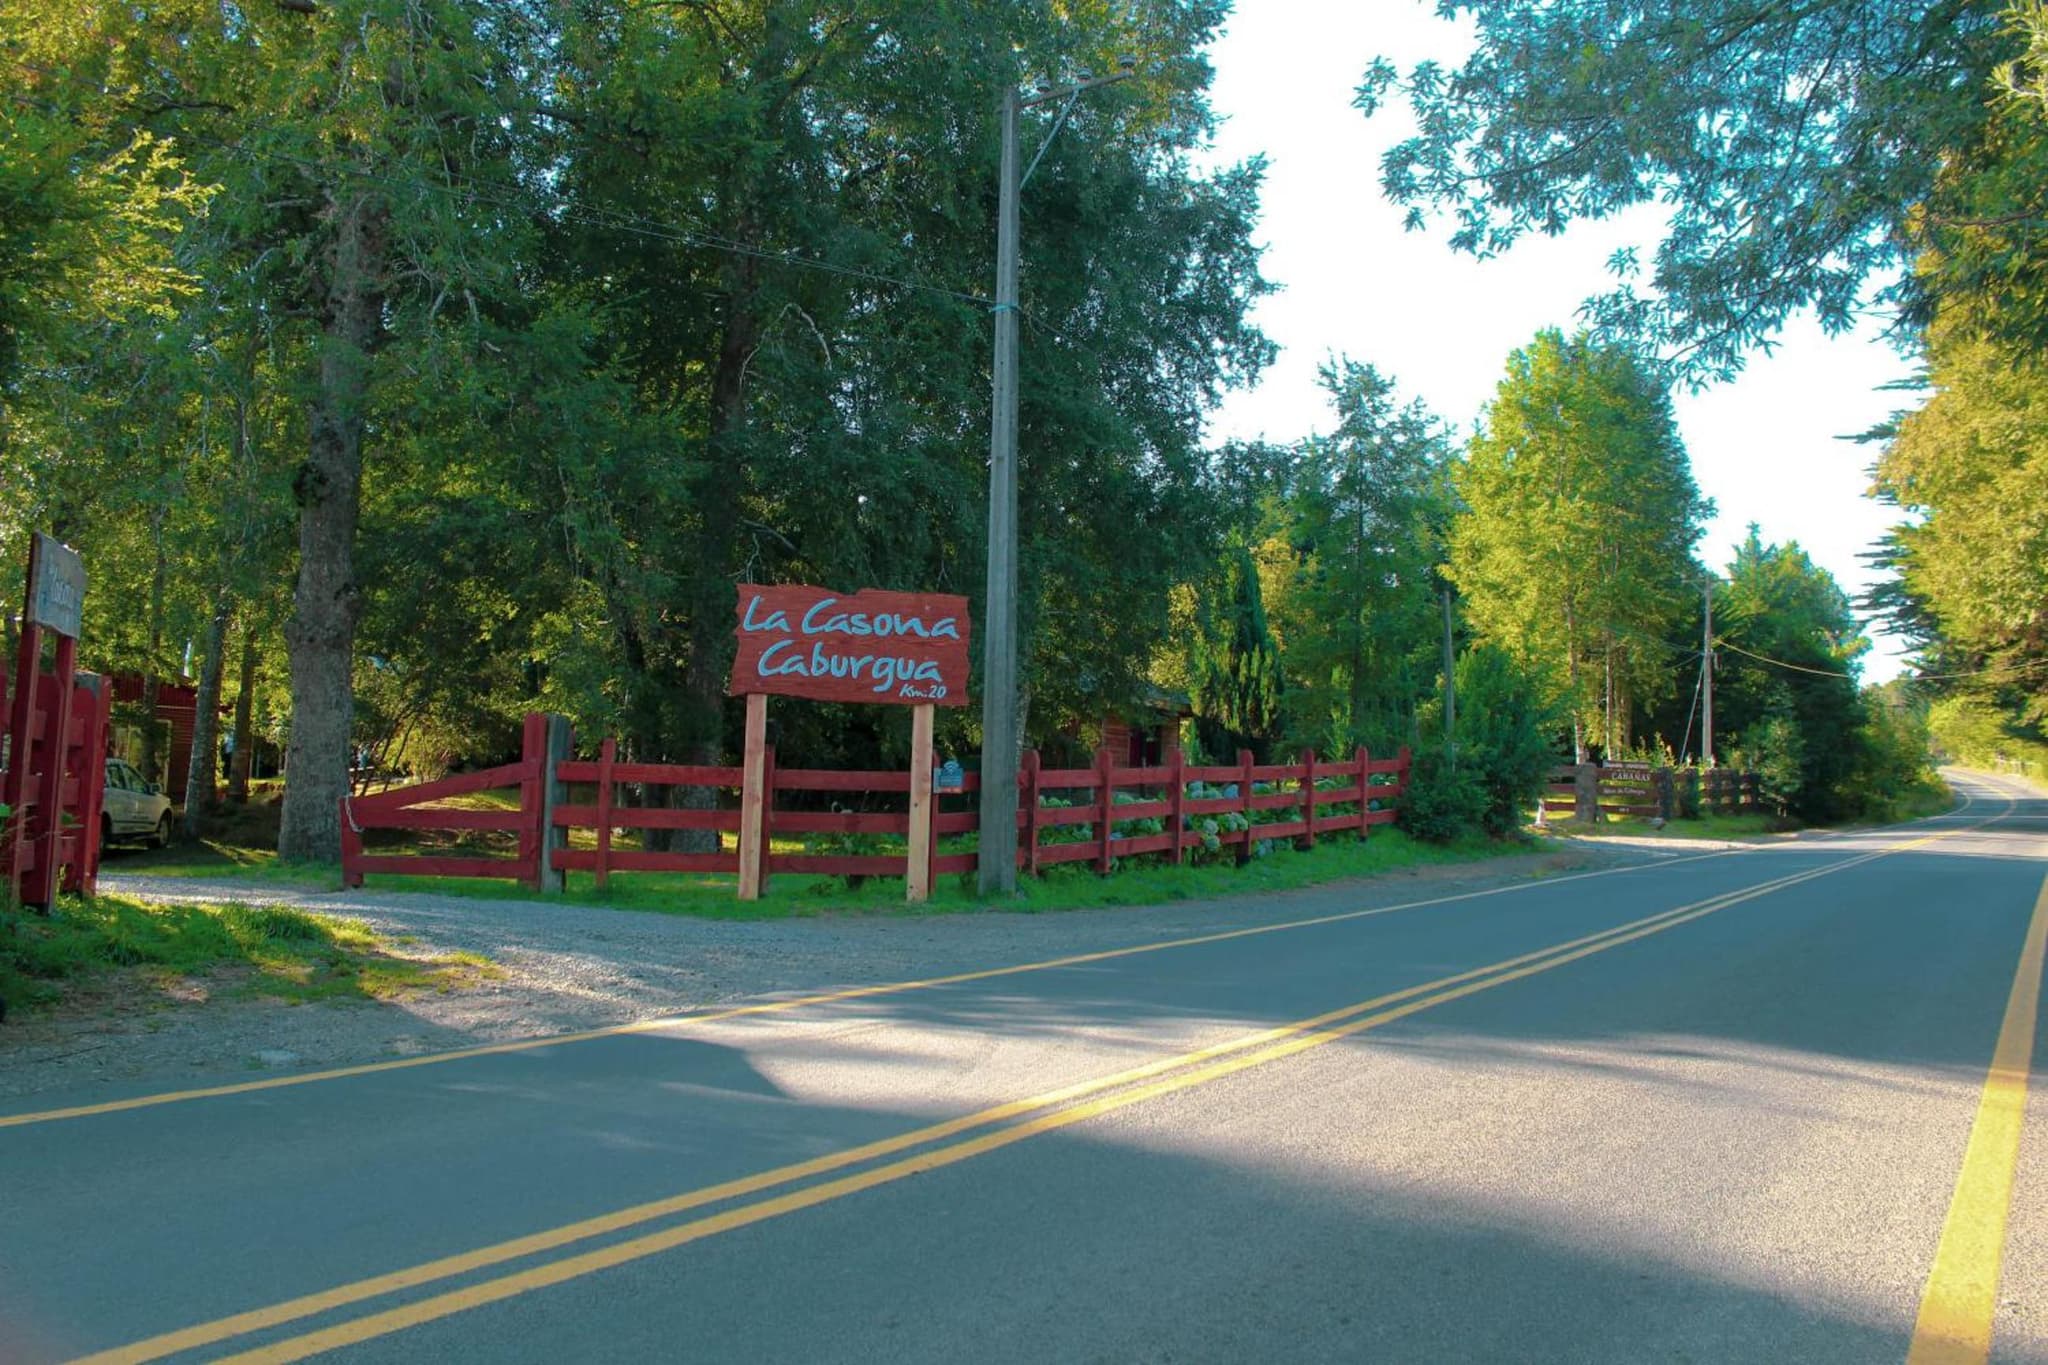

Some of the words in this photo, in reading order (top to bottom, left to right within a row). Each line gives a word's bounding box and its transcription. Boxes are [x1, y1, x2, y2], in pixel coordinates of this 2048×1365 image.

[743, 595, 791, 632] La
[802, 598, 960, 640] Casona
[758, 639, 942, 692] Caburgua
